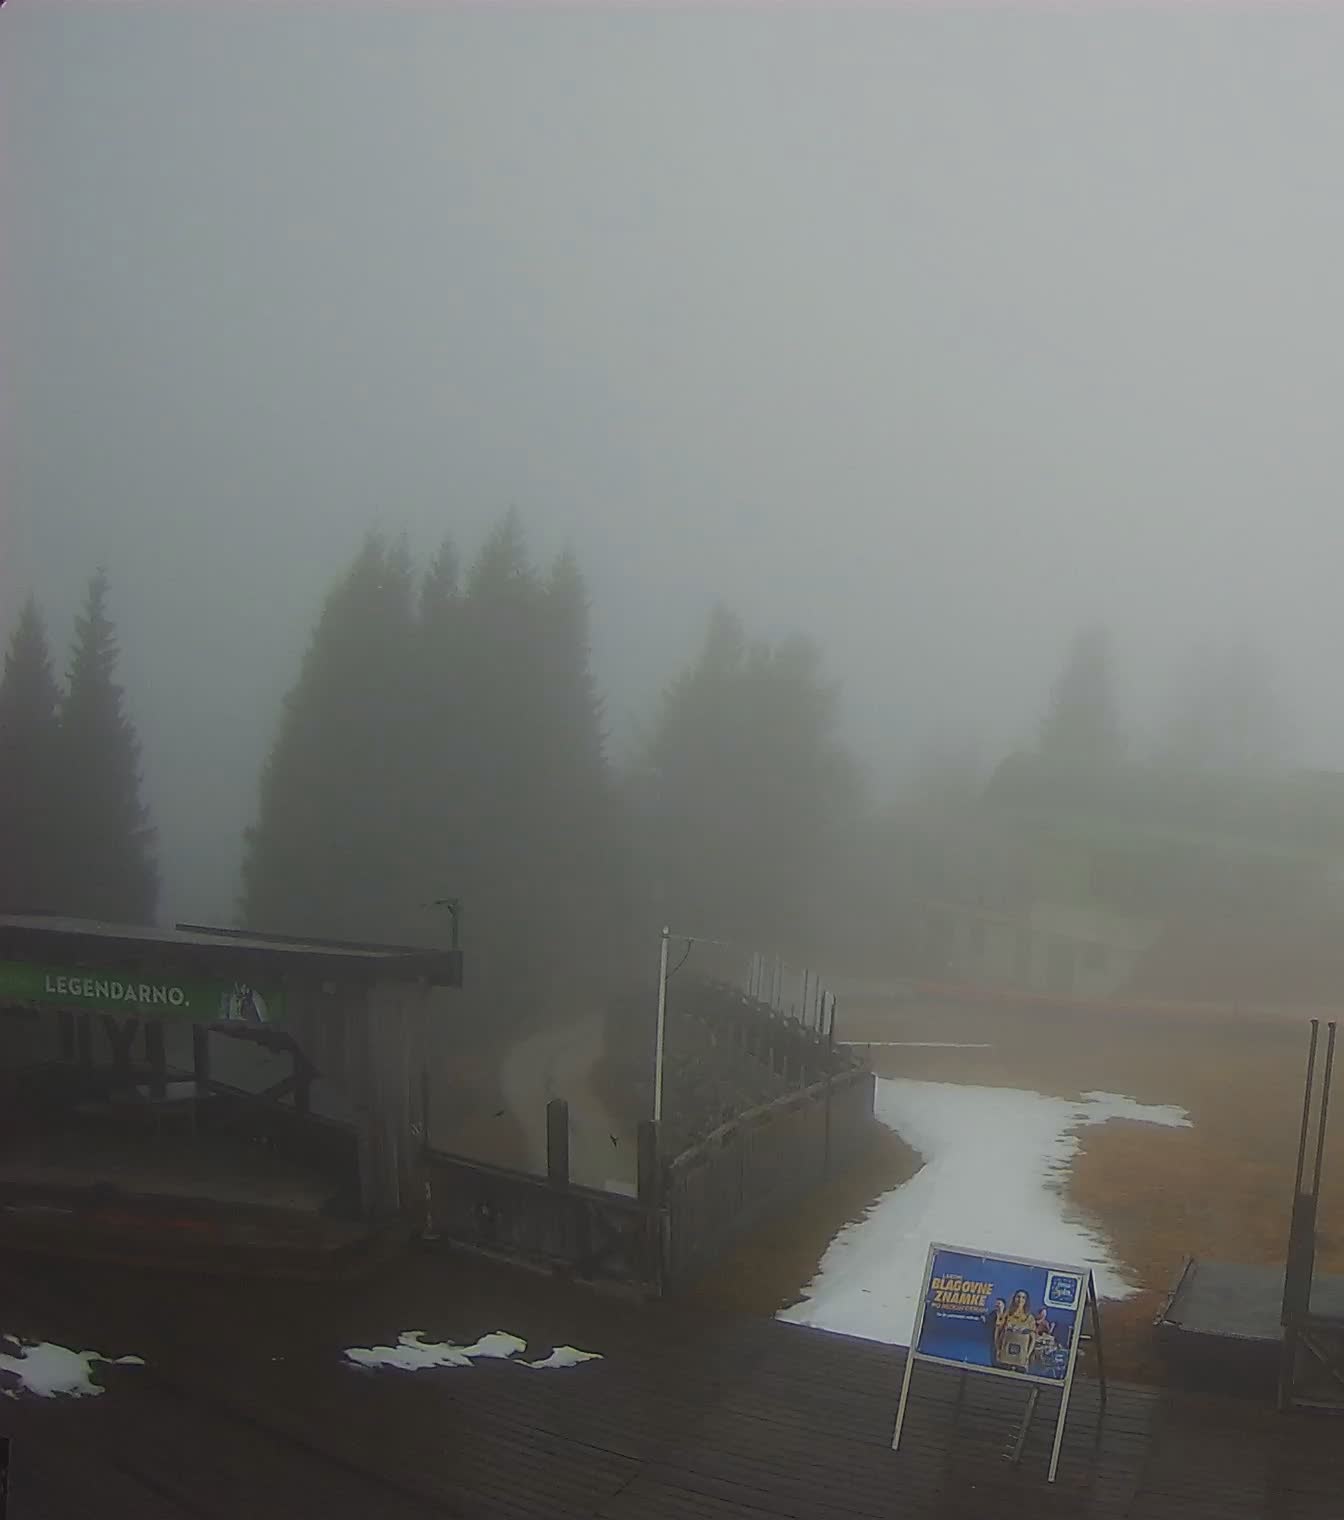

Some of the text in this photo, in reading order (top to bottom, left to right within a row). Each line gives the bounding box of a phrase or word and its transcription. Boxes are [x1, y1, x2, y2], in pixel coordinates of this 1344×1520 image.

[45, 975, 190, 1006] LEGENDARNO.
[931, 1278, 993, 1295] BLAGOVNE
[934, 1290, 987, 1307] ZNAMKE
